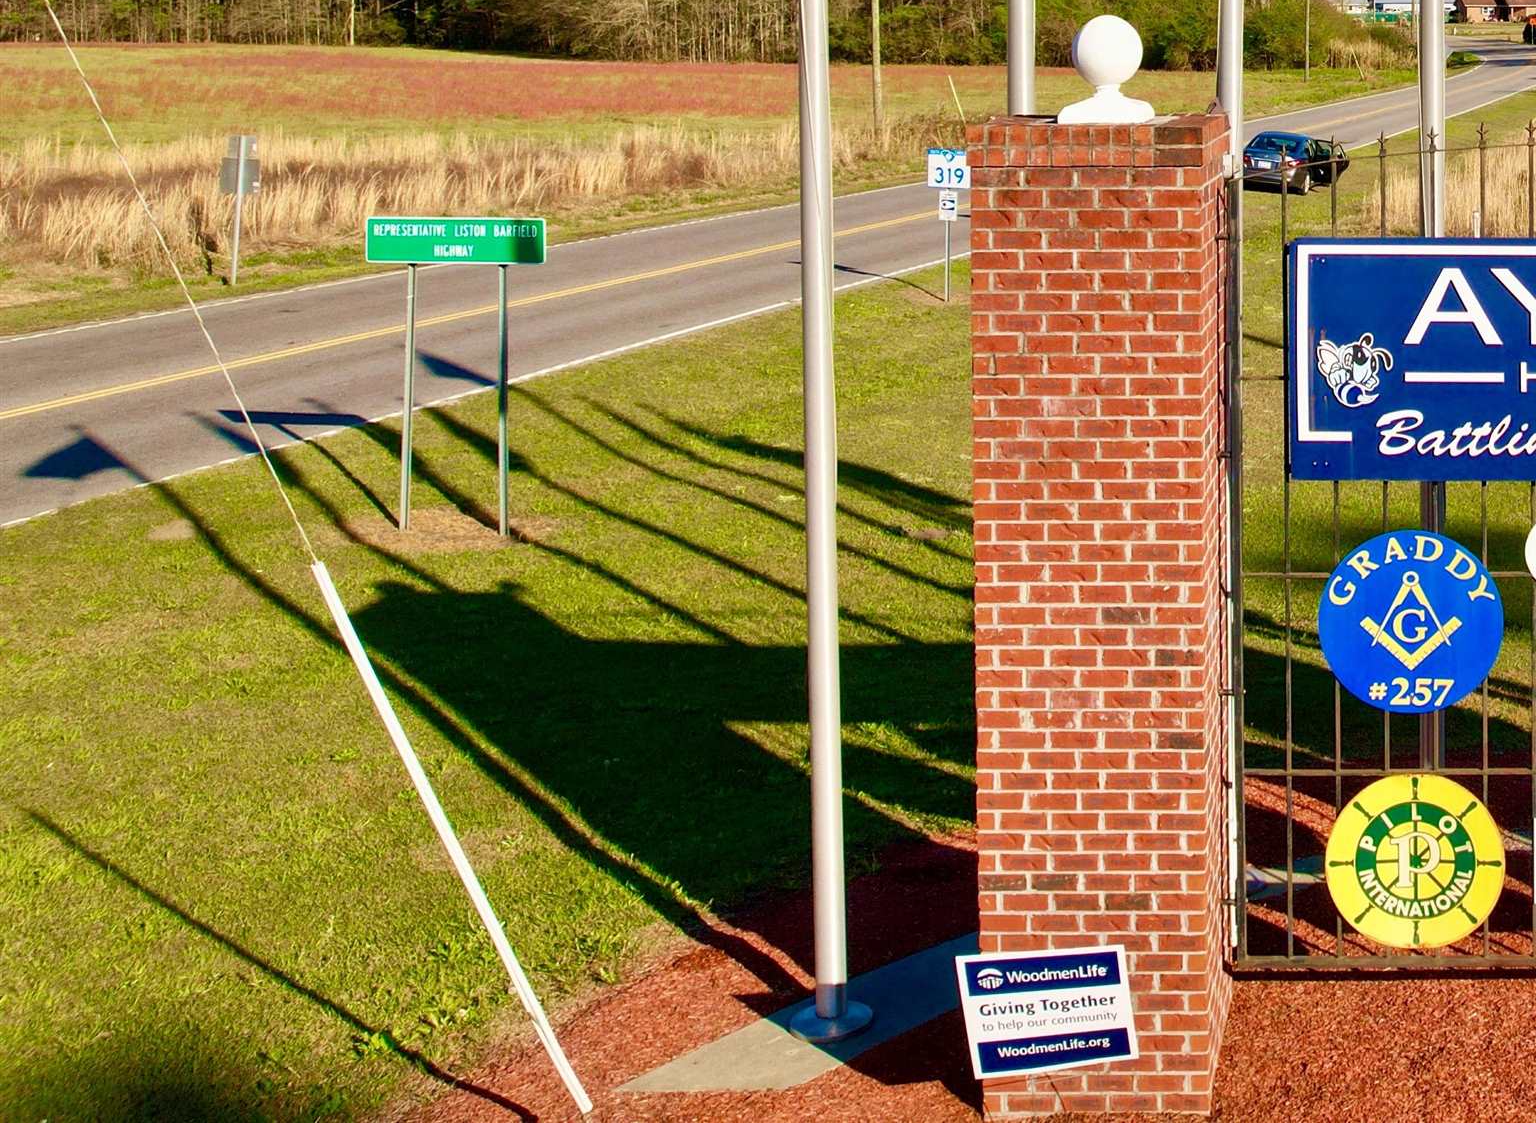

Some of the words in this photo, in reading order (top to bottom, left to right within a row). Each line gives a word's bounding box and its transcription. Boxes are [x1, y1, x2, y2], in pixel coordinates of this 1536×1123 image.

[935, 167, 964, 184] 319
[373, 224, 447, 237] REPRESENTATIVE
[455, 225, 486, 237] LISTON
[493, 225, 537, 238] BARFIELD
[433, 244, 474, 257] HIGHWAY
[1328, 535, 1496, 606] GRADDY
[1392, 608, 1428, 643] G
[1369, 677, 1455, 707] #257
[1359, 803, 1473, 854] PILOT
[1390, 832, 1441, 888] P
[1359, 869, 1473, 917] INTERNATIONAL
[1006, 964, 1107, 984] WoodmenLife
[979, 1001, 1036, 1017] Giving
[1040, 995, 1117, 1012] Together
[982, 1023, 994, 1032] to
[997, 1019, 1024, 1032] help
[1027, 1018, 1048, 1028] our
[1051, 1011, 1118, 1026] community
[997, 1037, 1111, 1058] WoodmenLife.org
